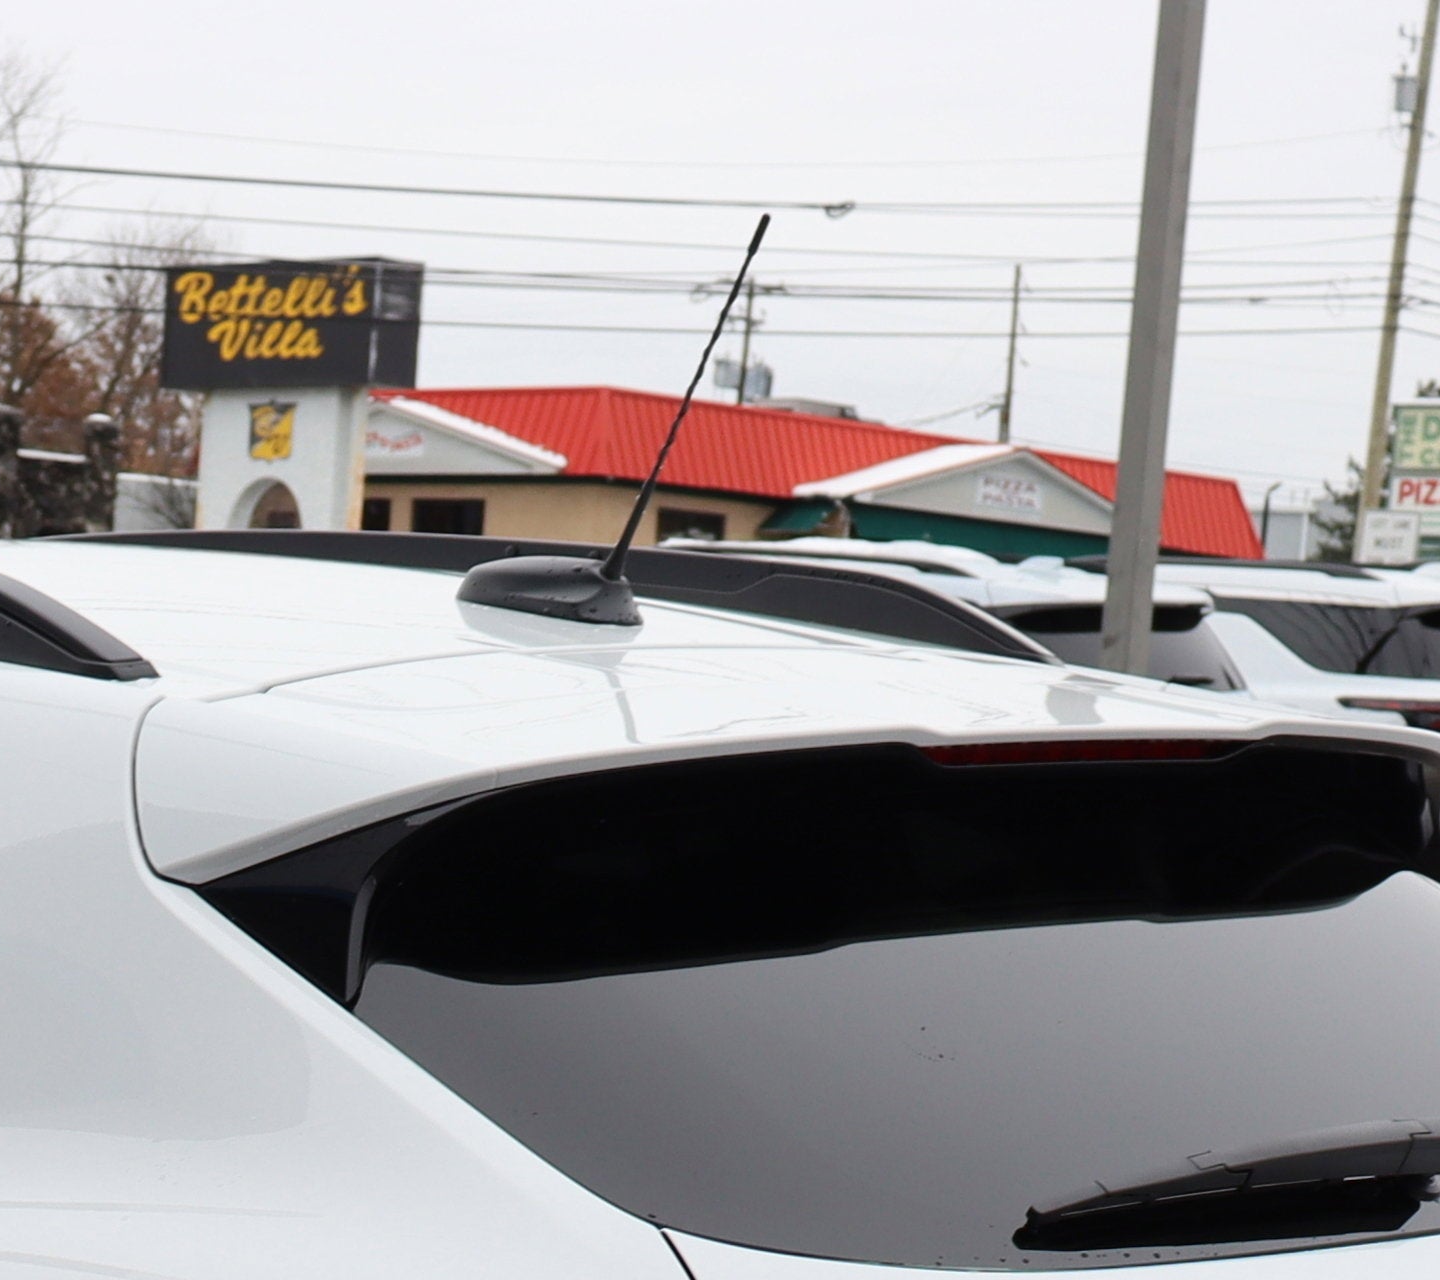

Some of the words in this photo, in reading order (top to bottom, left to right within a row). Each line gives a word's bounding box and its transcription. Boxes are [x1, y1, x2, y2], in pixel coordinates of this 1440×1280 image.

[174, 264, 368, 324] Bettelli's
[206, 319, 324, 361] Villa
[1399, 414, 1417, 460] THE
